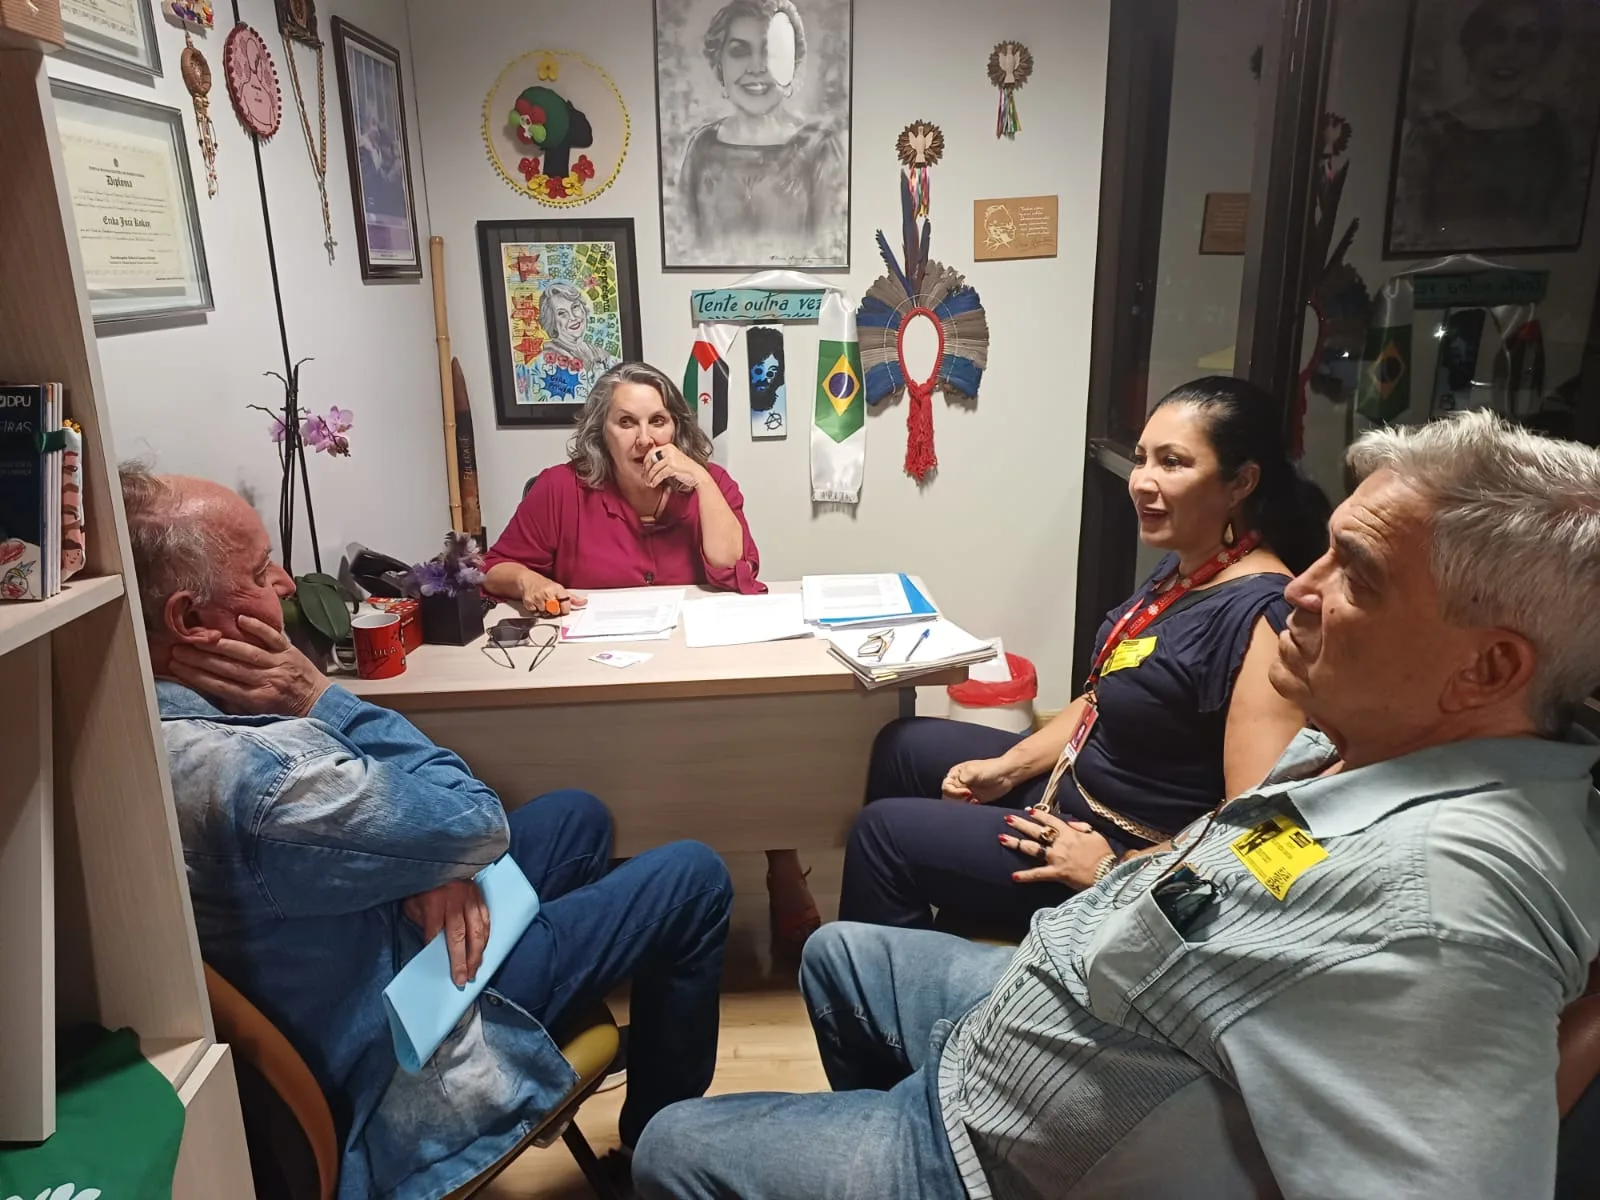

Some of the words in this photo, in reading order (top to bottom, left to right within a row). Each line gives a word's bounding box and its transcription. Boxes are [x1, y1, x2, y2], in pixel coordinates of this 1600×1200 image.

[105, 174, 133, 188] Diploma
[694, 290, 738, 313] Tente
[744, 292, 788, 312] outra
[7, 395, 31, 407] DPU
